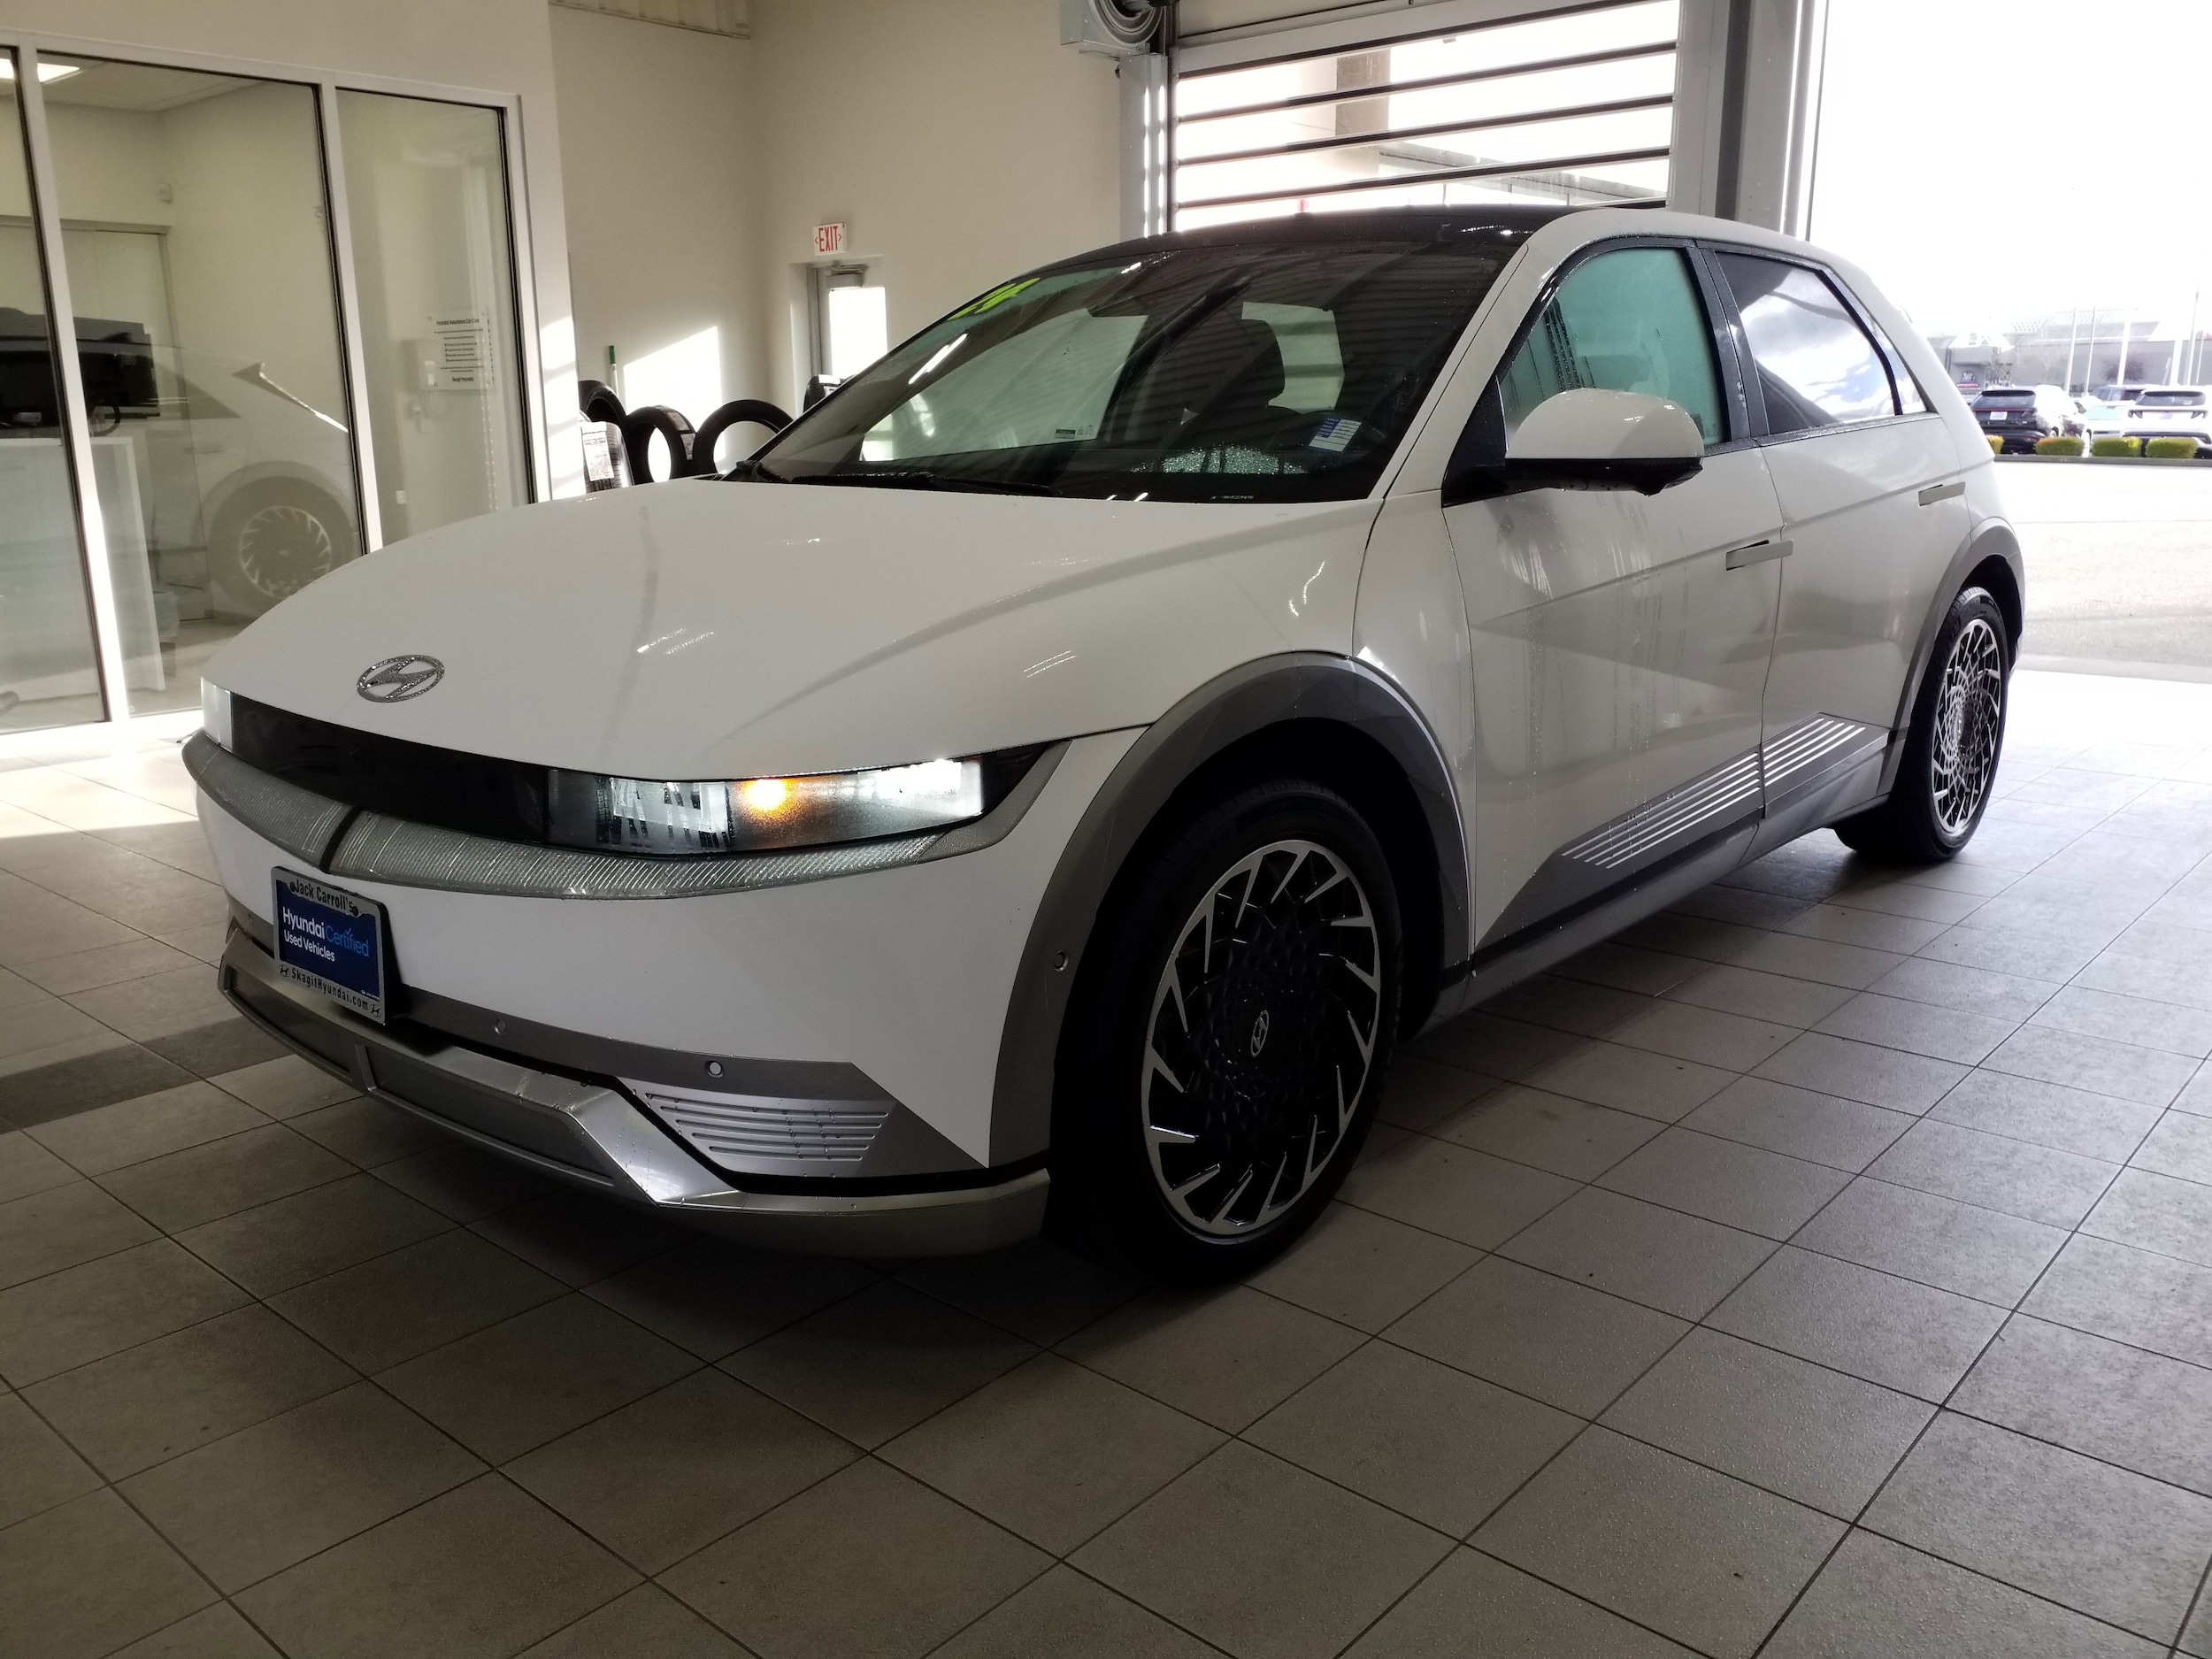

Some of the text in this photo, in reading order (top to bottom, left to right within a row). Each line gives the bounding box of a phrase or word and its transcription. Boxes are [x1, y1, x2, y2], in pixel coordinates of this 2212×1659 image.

[818, 226, 838, 252] EXIT
[295, 879, 354, 912] Jack Carroll's
[282, 906, 326, 940] Hyundai
[284, 930, 335, 963] Used Vehicles
[292, 967, 369, 1010] SkagitHyundai.com
